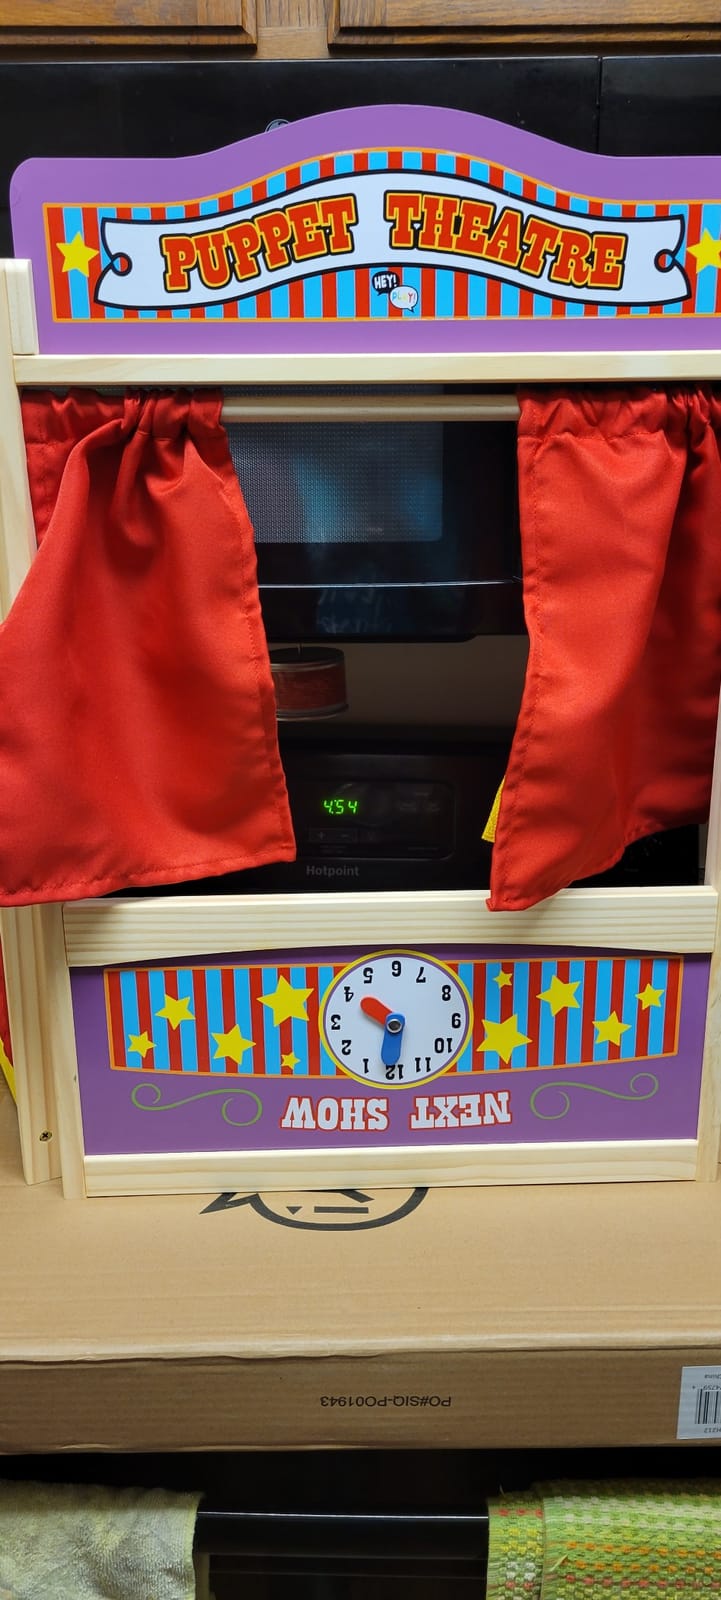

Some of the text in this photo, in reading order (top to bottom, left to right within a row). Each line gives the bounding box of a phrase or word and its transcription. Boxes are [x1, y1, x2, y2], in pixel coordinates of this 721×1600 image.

[161, 191, 629, 292] PUPPET THEATRE
[374, 274, 397, 289] HEY!
[306, 865, 360, 877] Hotpoint
[363, 967, 374, 984] 5
[391, 960, 402, 977] 6
[415, 966, 426, 983] 7
[344, 986, 354, 1002] 4
[441, 985, 451, 1001] 8
[330, 1014, 341, 1030] 3
[451, 1013, 461, 1029] 9
[341, 1039, 351, 1055] 2
[434, 1038, 453, 1053] 10
[362, 1058, 369, 1074] 1
[385, 1064, 404, 1080] 12
[415, 1057, 431, 1073] 11
[280, 1090, 512, 1131] NEXT SHOW
[320, 1395, 452, 1407] PO#SIQ-PO01943
